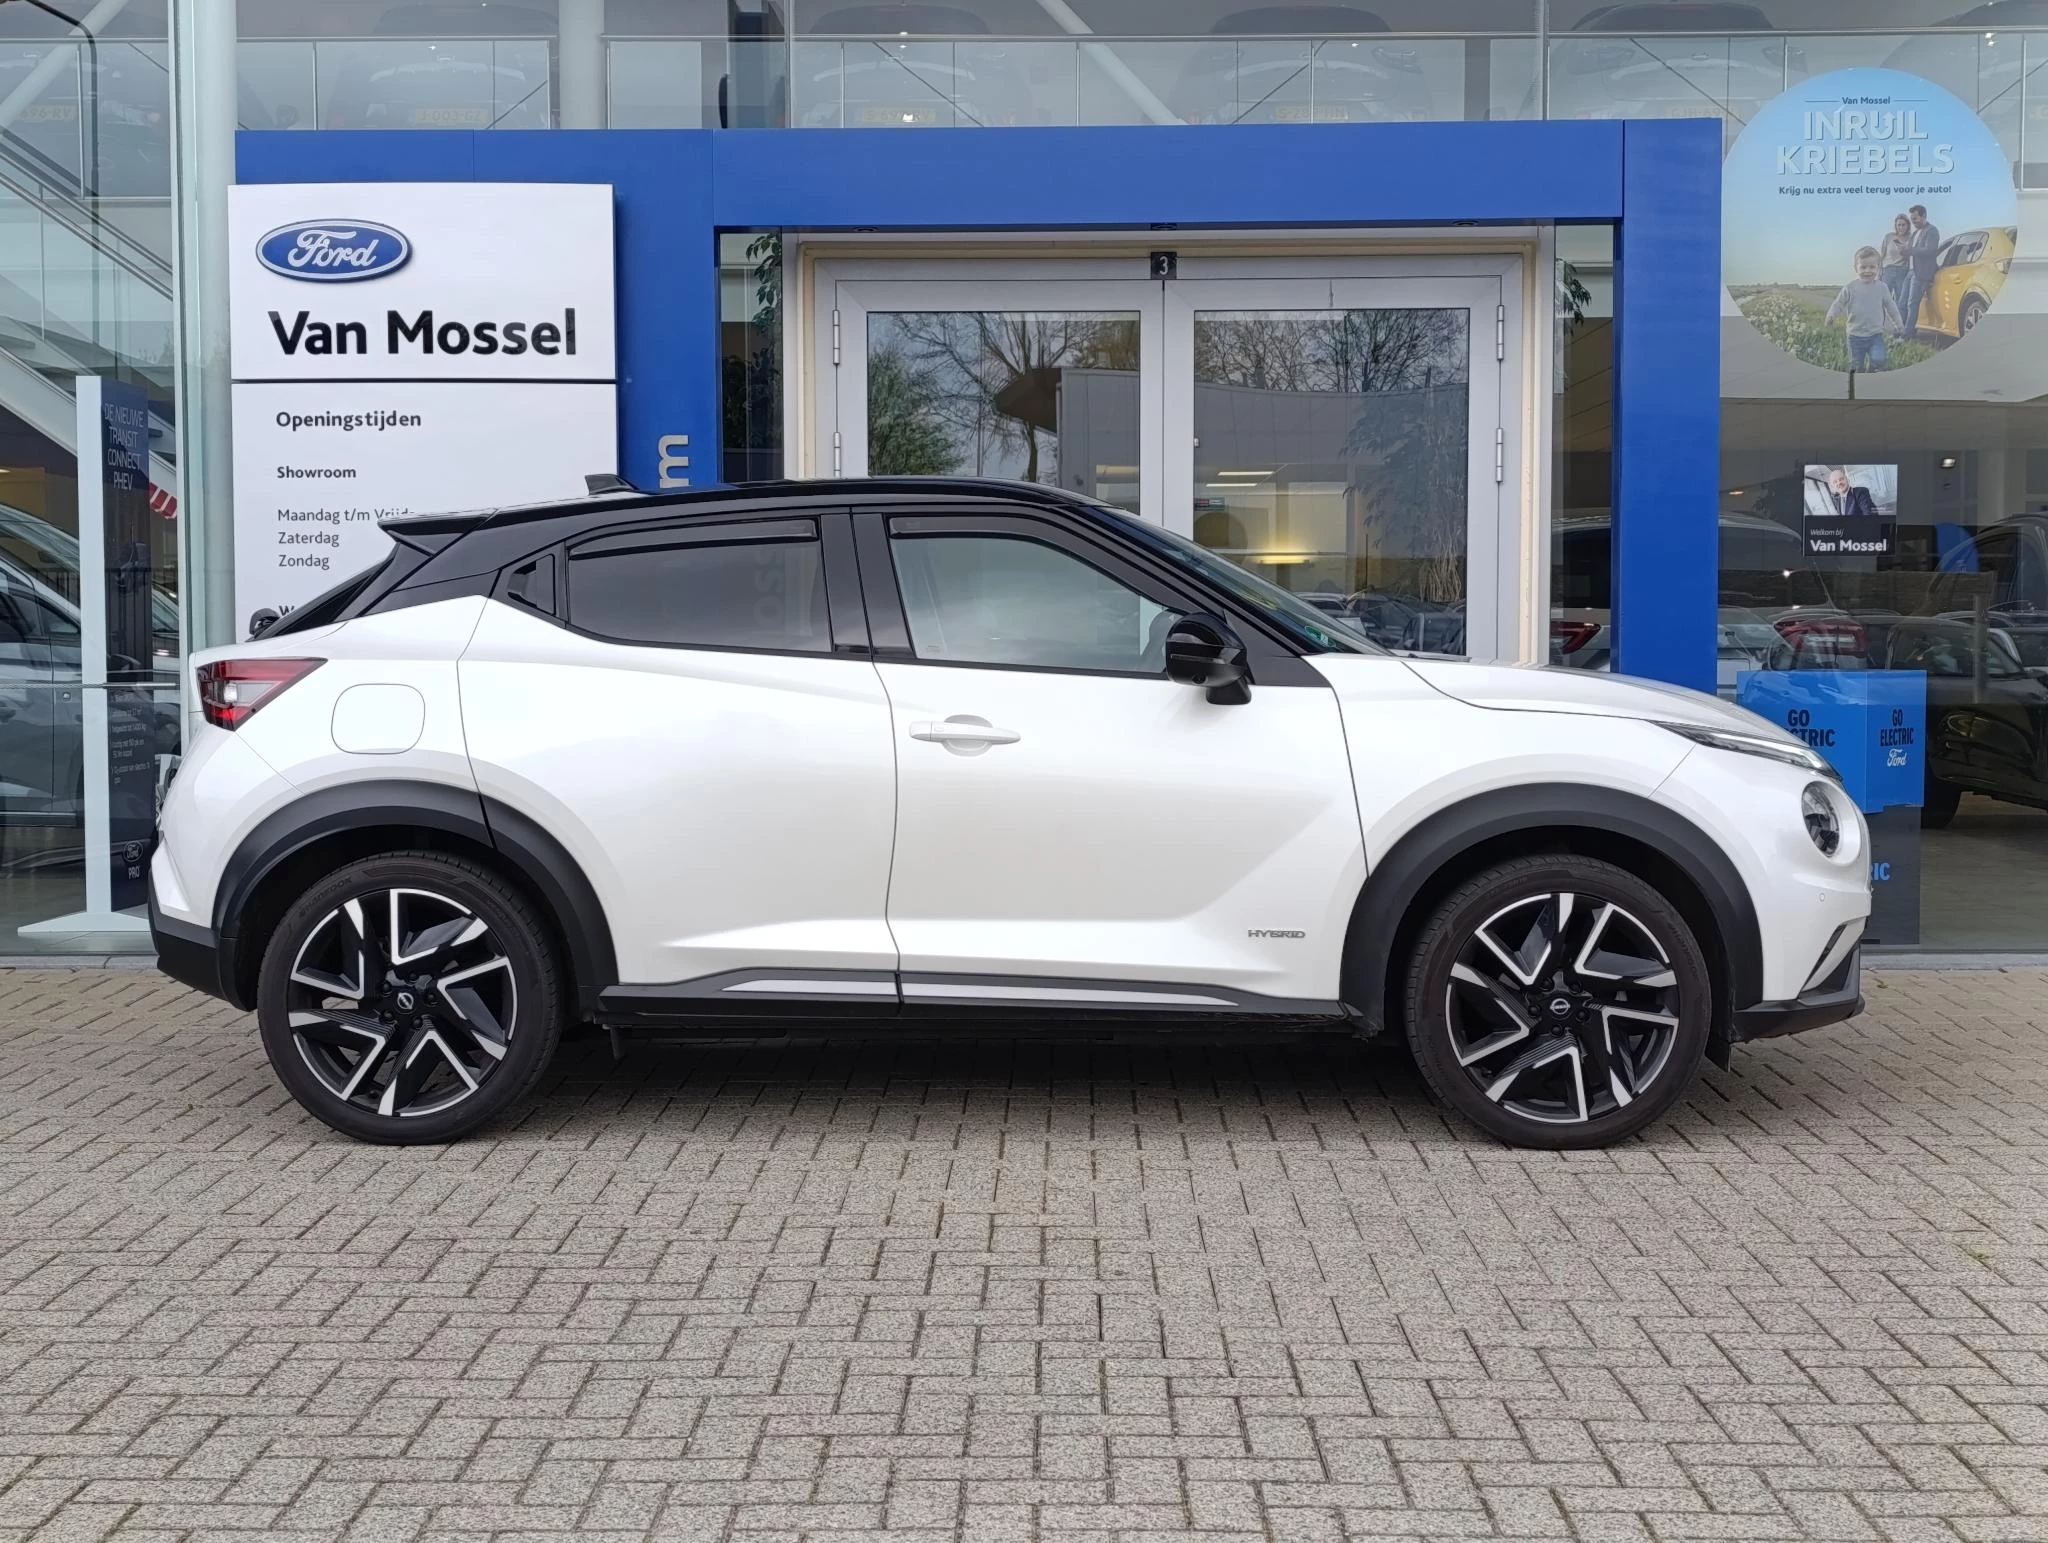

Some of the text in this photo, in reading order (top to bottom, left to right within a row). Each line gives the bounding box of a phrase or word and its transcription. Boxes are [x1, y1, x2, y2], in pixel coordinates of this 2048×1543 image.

[1842, 96, 1891, 105] Van Mossel
[1804, 110, 1928, 141] INRUIL
[1776, 144, 1955, 175] KRIEBELS
[1779, 185, 1801, 196] Krijg
[1817, 186, 1842, 194] extra
[1844, 185, 1864, 194] veel
[1866, 185, 1891, 195] terug
[1916, 184, 1925, 195] je
[1927, 184, 1952, 193] auto!
[287, 229, 380, 268] Ford
[1159, 255, 1169, 276] 3
[267, 307, 577, 356] Van Mossel
[104, 402, 145, 428] DE NIEUWE
[276, 410, 422, 432] Openingstijden
[108, 426, 139, 448] TRANSIT
[107, 447, 142, 471] CONNECT
[113, 470, 134, 491] PHEV
[276, 465, 357, 479] Showroom
[277, 508, 341, 525] Maandag
[343, 508, 370, 521] t/m
[278, 531, 340, 548] Zaterdag
[1810, 527, 1845, 538] Welkom bij
[1809, 538, 1888, 552] Van Mossel
[278, 554, 330, 571] Zondag
[1787, 708, 1810, 727] GO
[1891, 708, 1904, 727] GO
[1879, 727, 1914, 747] ELECTRIC
[1886, 748, 1908, 767] Ford
[128, 865, 140, 880] PRO
[1247, 929, 1306, 939] HYBRID
